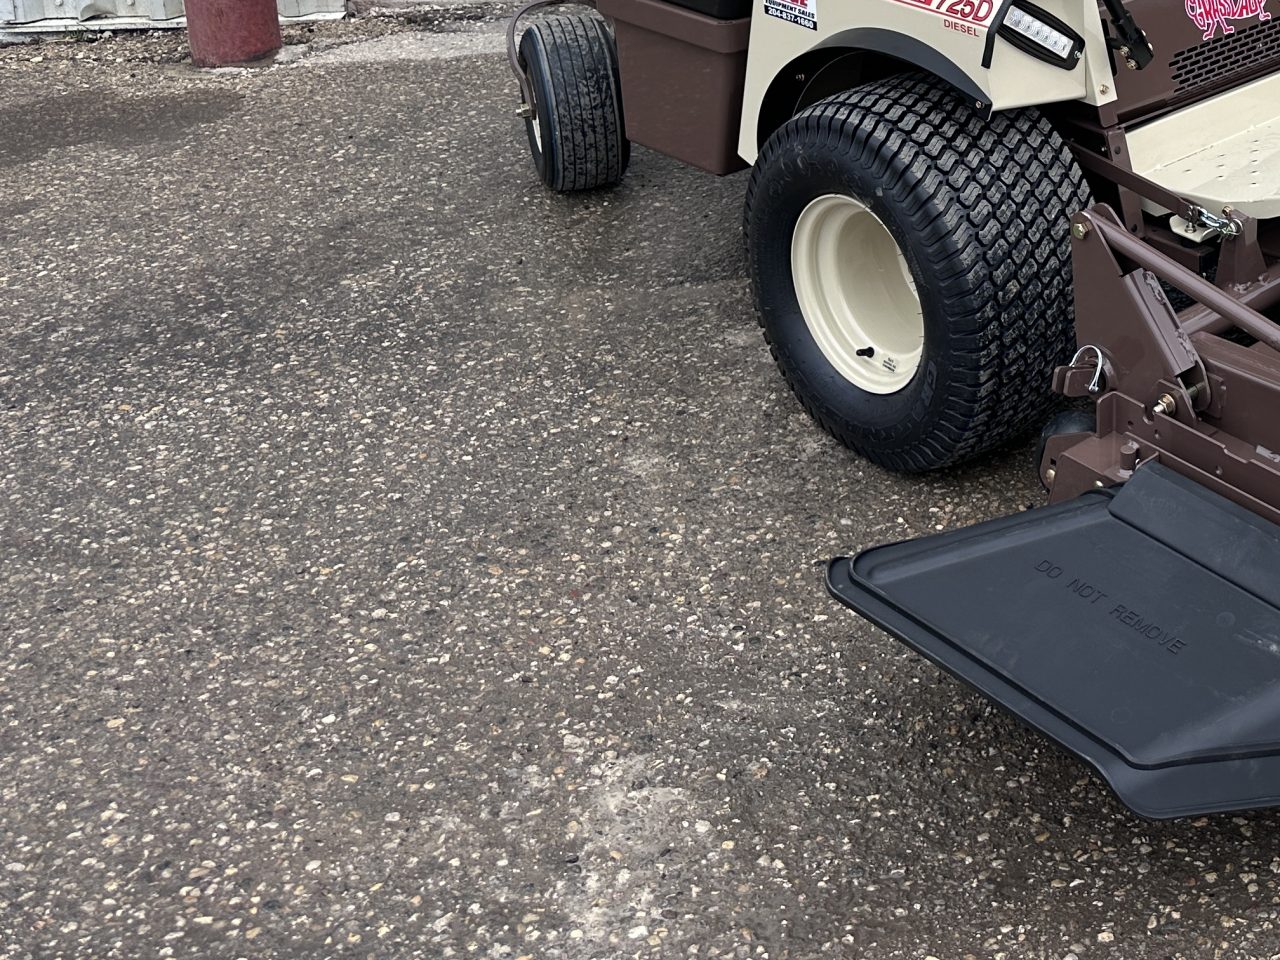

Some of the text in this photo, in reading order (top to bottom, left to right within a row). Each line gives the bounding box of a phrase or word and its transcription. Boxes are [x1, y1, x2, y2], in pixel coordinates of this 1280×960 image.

[797, 8, 815, 19] SALES
[944, 19, 980, 38] DIESEL
[1034, 559, 1187, 656] DO NOT REMOVE
